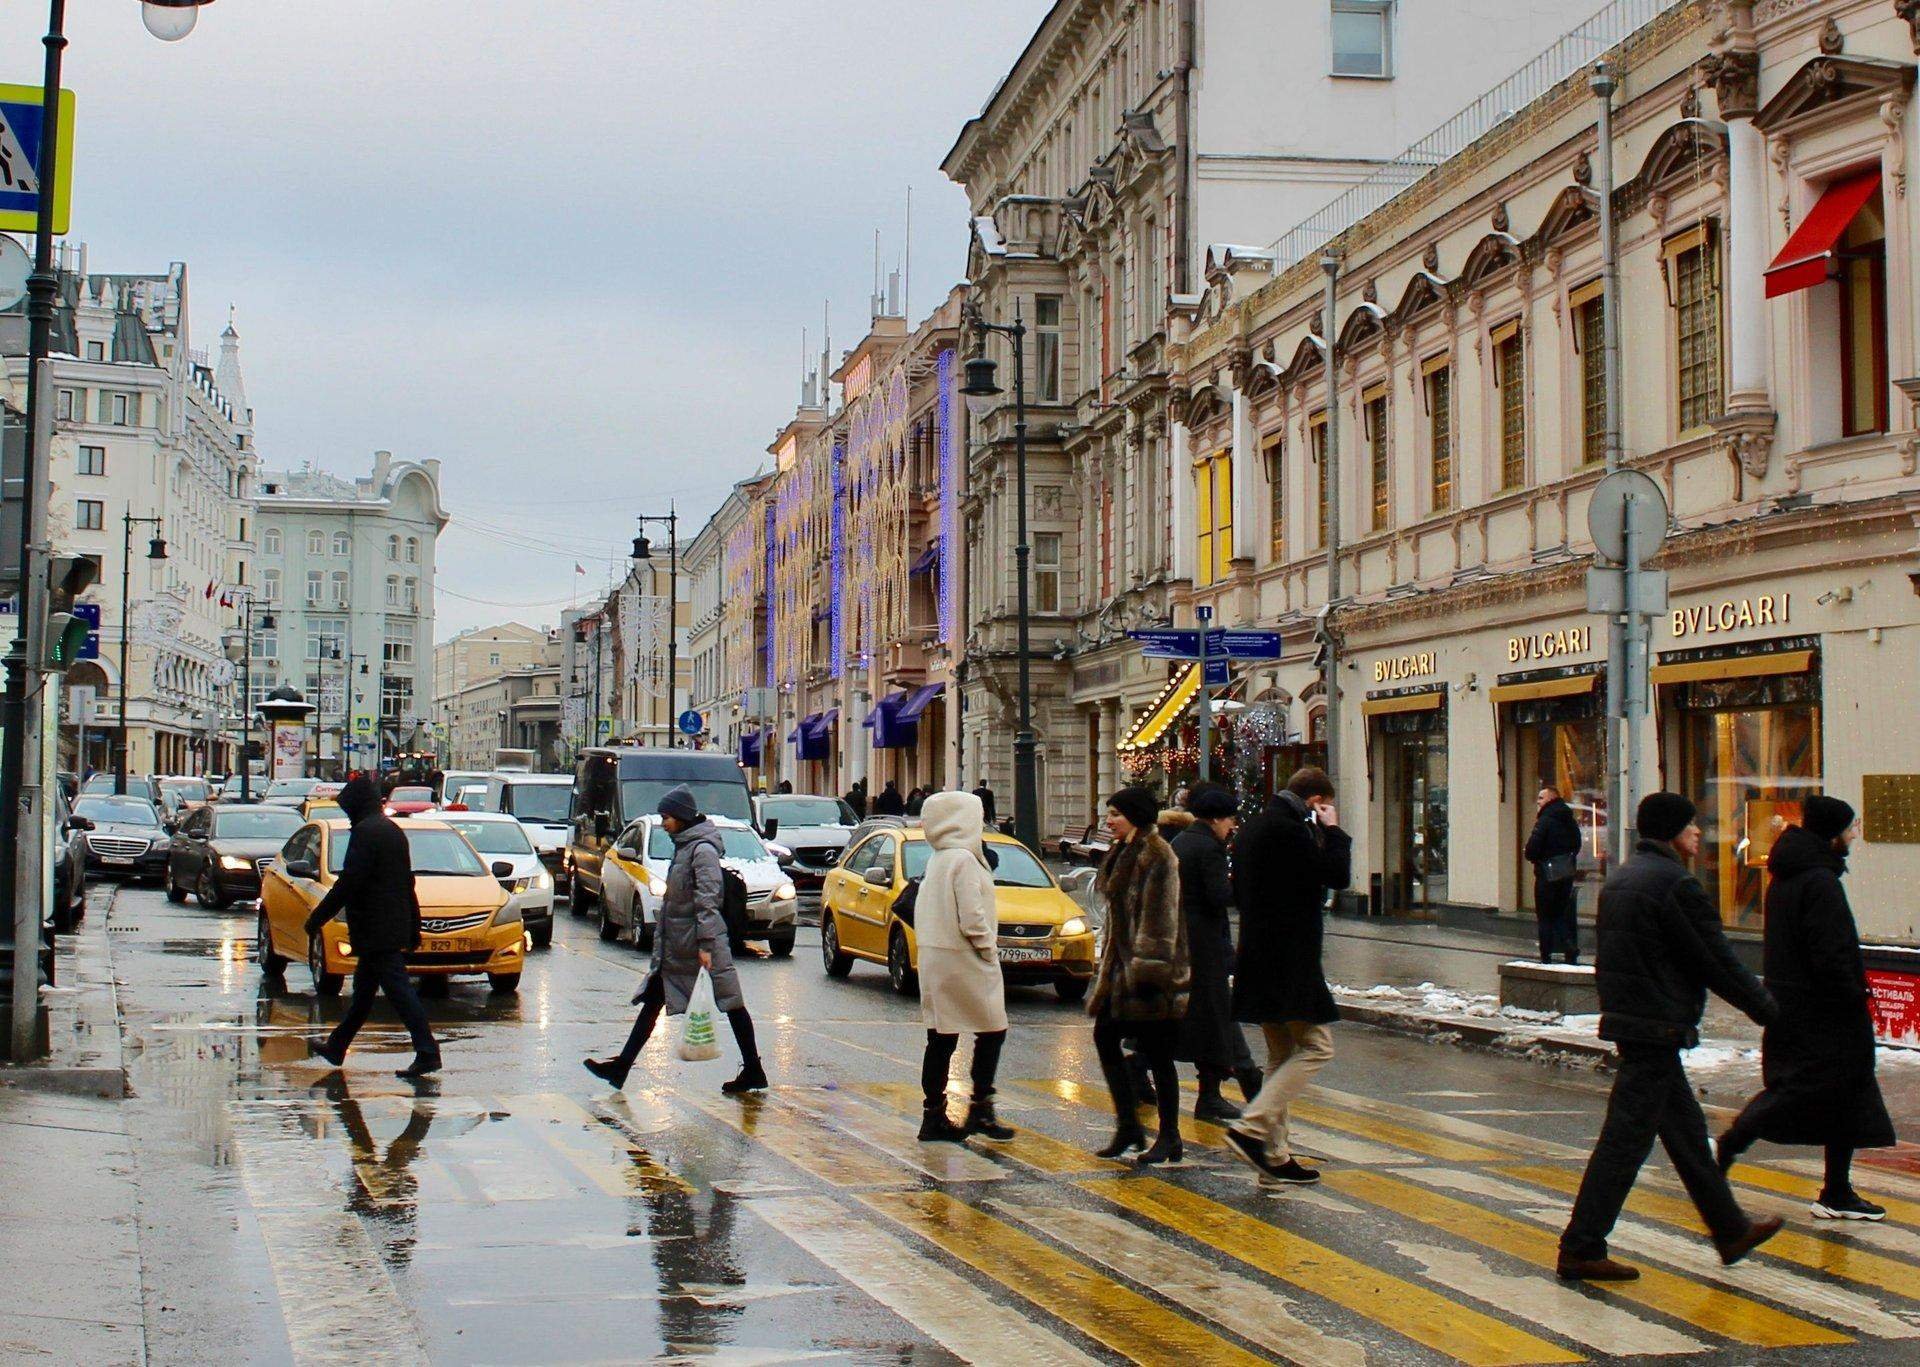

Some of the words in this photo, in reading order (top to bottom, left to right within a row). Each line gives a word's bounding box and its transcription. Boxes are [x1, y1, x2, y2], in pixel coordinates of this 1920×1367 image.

[1672, 593, 1790, 637] BVLGARI
[1508, 626, 1590, 663] BVLGARI
[1375, 651, 1436, 682] BVLGARI
[1872, 987, 1915, 1002] ЕСТИВАЛЬ
